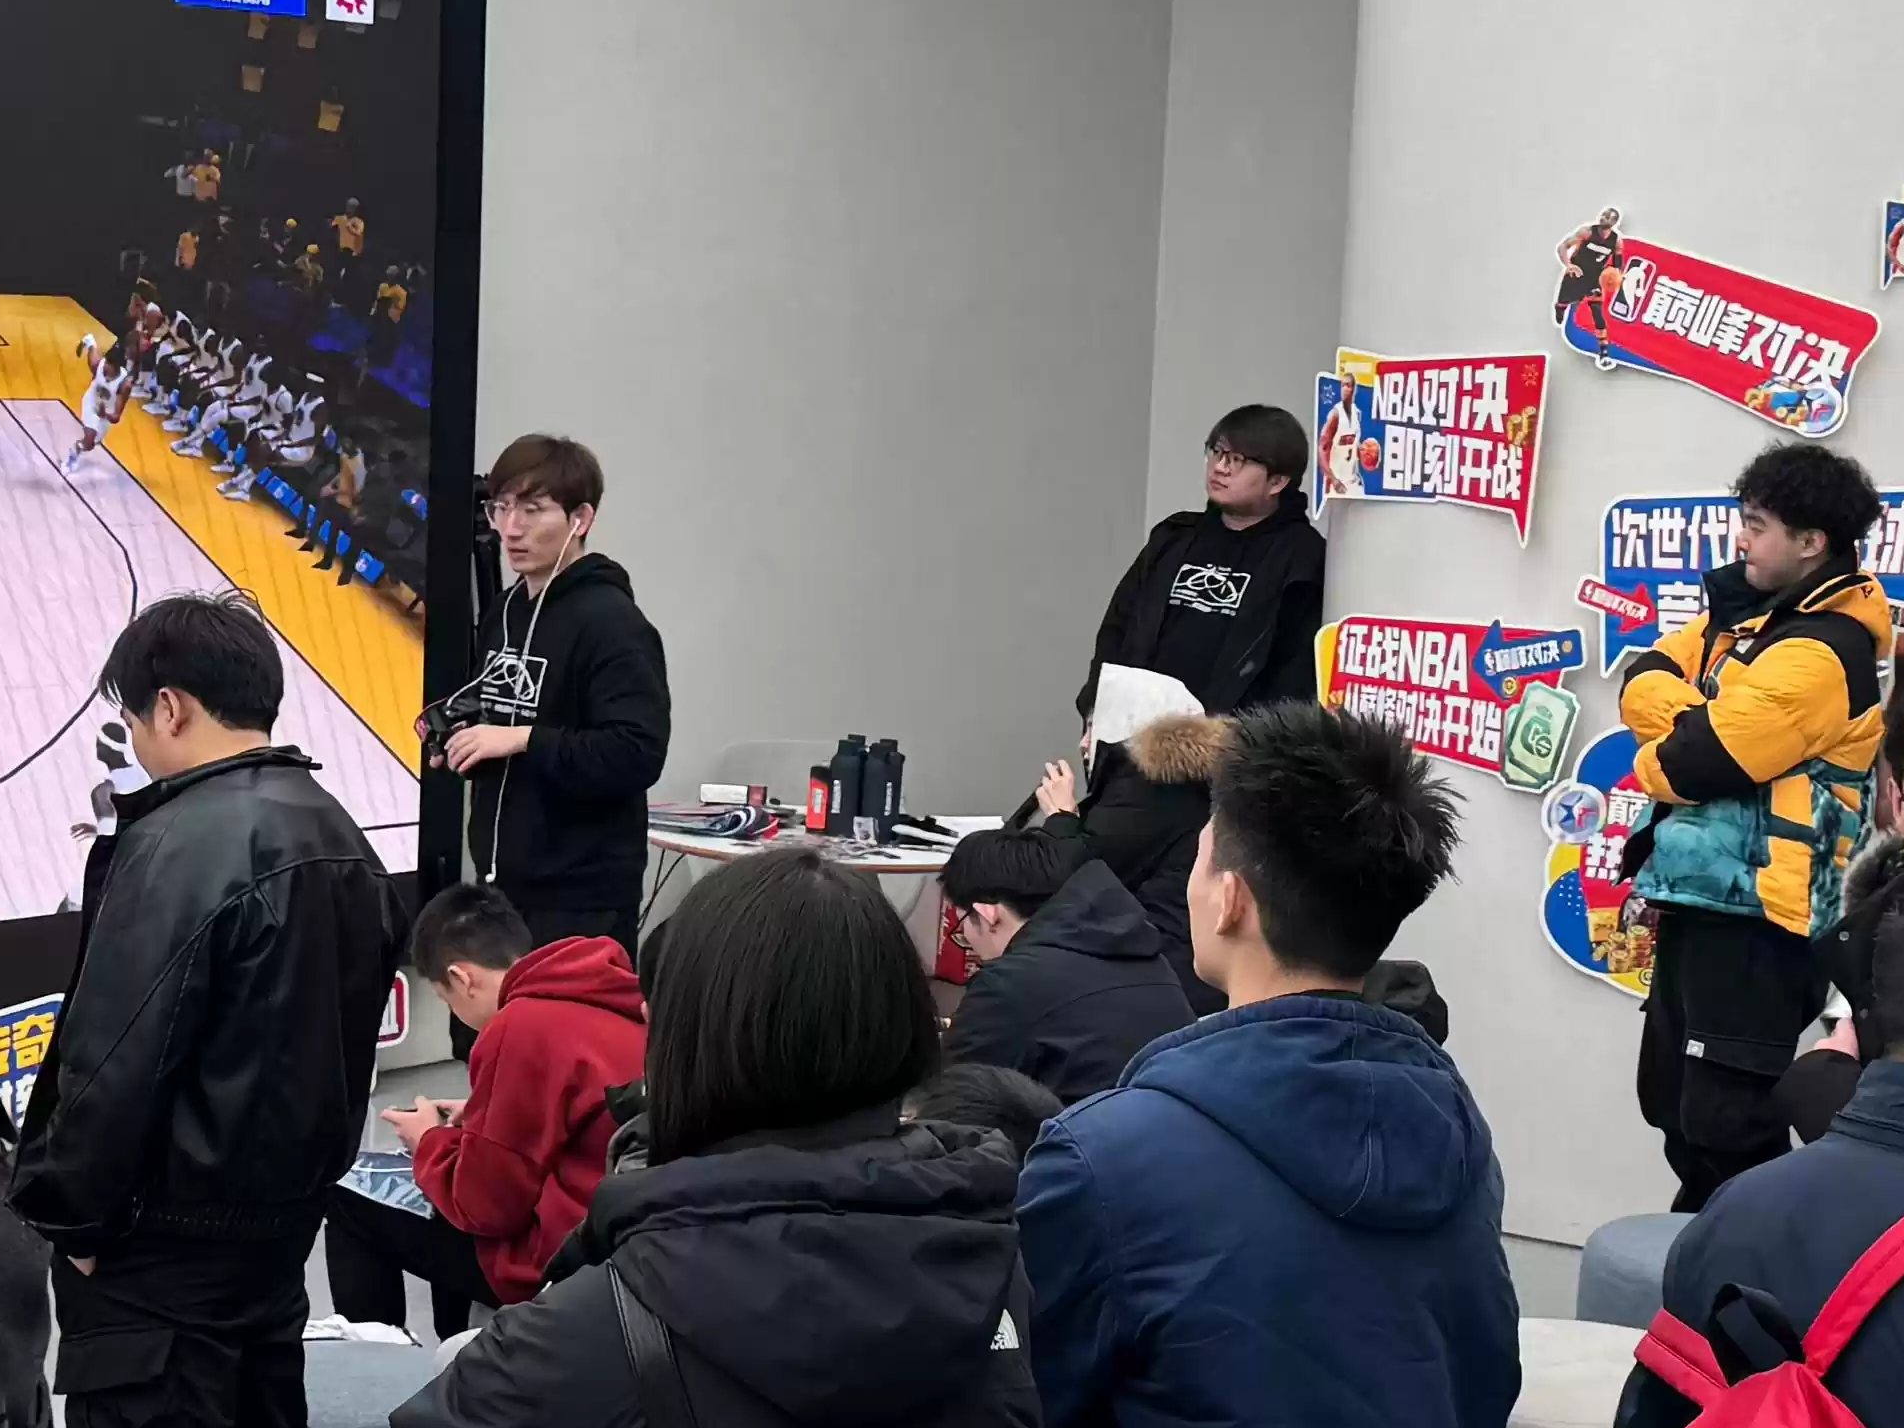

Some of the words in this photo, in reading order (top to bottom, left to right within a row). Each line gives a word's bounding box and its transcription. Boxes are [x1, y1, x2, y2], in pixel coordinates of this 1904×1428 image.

[1642, 275, 1850, 384] 巅峰对决
[1371, 363, 1509, 433] NBA对决
[1382, 424, 1523, 501] 即刻开战
[1338, 623, 1469, 693] 征战NBA
